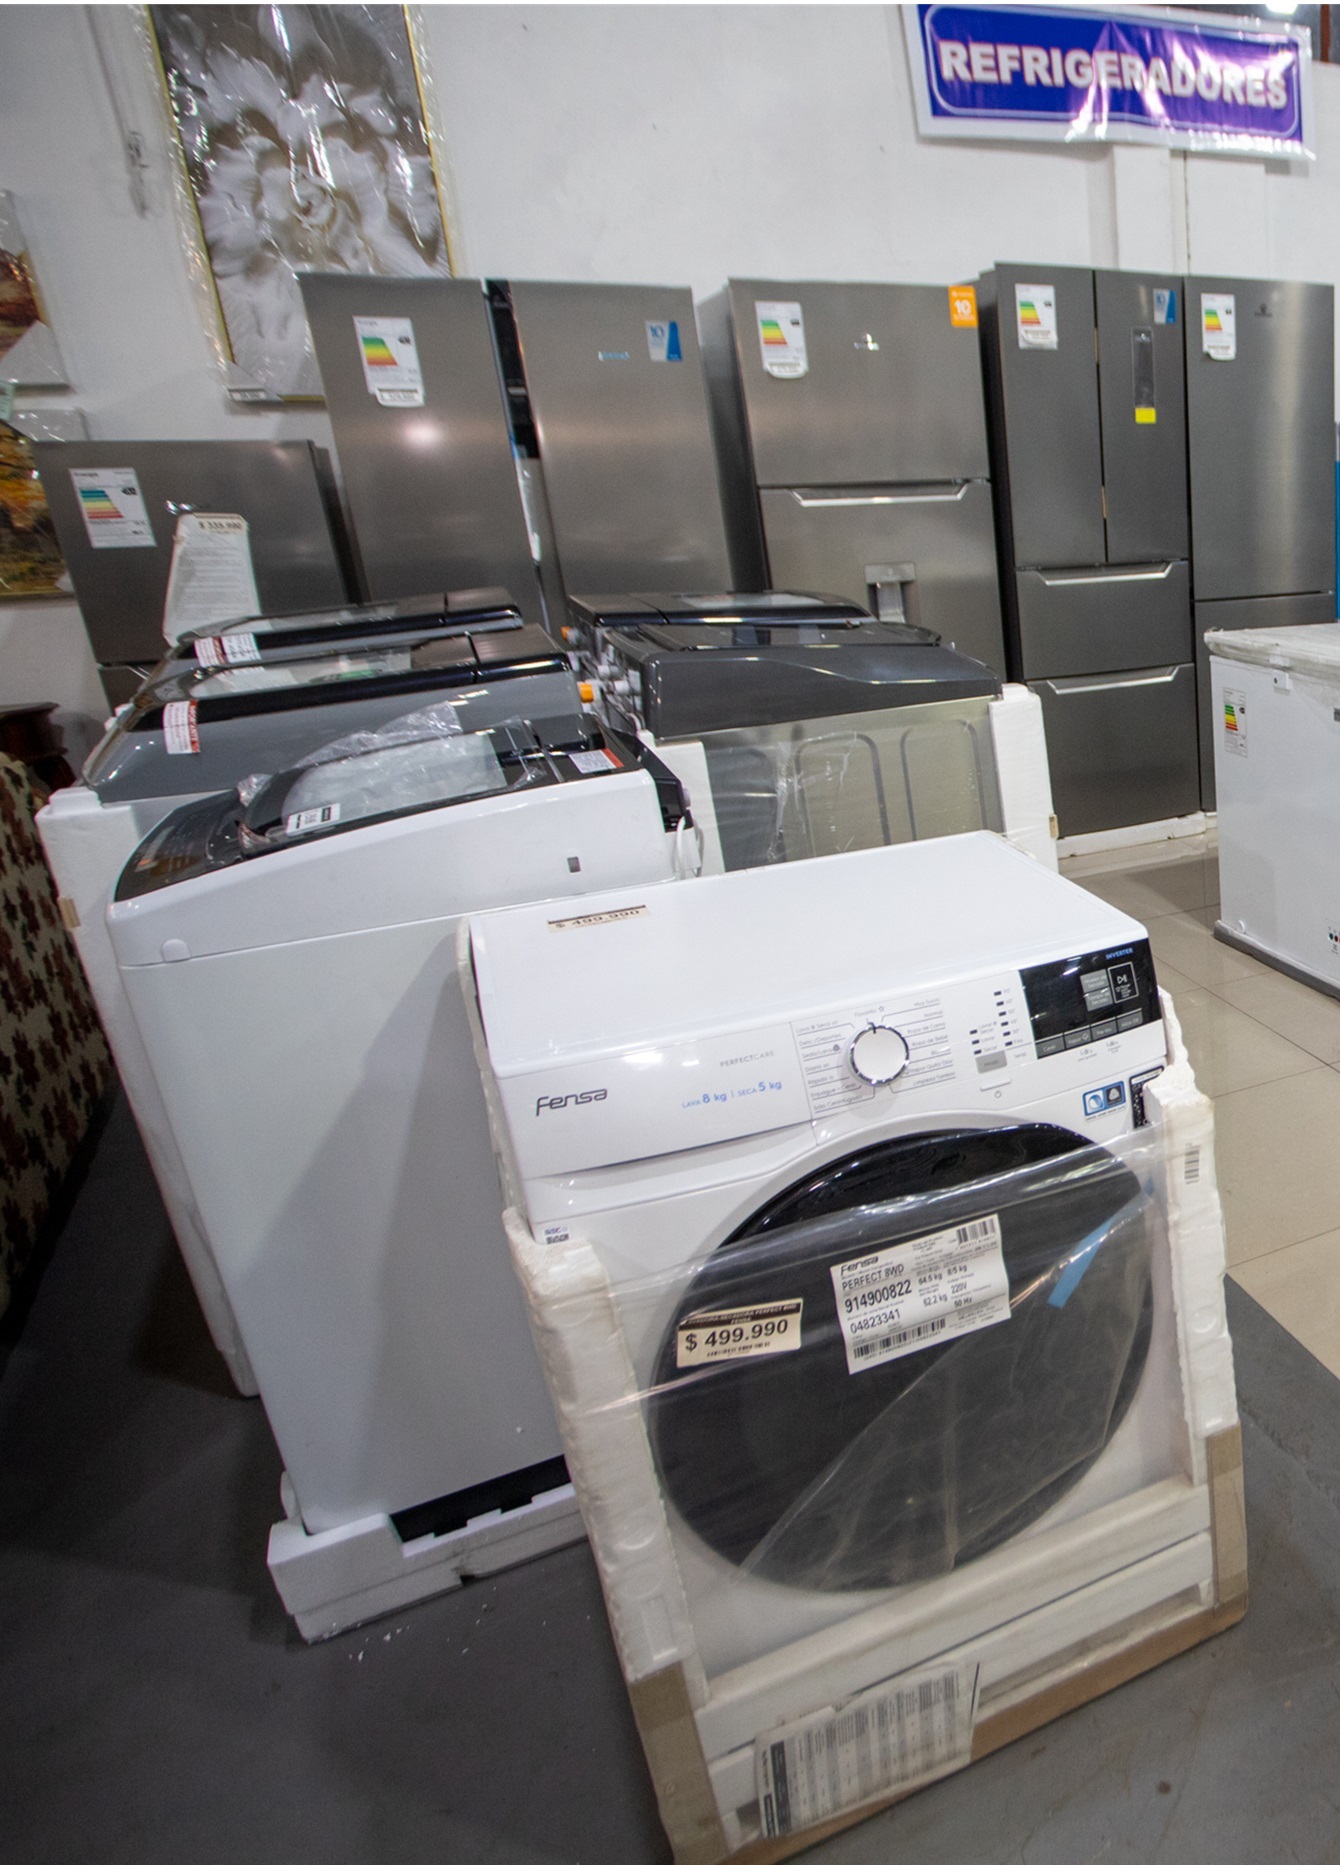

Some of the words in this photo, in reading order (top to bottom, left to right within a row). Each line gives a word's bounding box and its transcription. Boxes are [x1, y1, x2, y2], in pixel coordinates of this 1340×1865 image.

[938, 40, 1289, 110] REFRIGERADORES
[955, 299, 972, 317] 10
[649, 324, 665, 341] 10
[1105, 948, 1134, 959] INVERTER
[720, 1050, 775, 1068] PERFECTCARE
[536, 1088, 607, 1117] Fensa
[682, 1100, 701, 1109] LAVA
[702, 1093, 710, 1104] 8
[714, 1091, 727, 1103] kg
[737, 1086, 757, 1096] SECA
[758, 1081, 767, 1092] 5
[769, 1080, 782, 1092] kg
[840, 1256, 879, 1276] Fensa
[842, 1270, 882, 1291] PERFECT
[885, 1264, 905, 1278] 8WD
[959, 1264, 968, 1274] kg
[845, 1279, 912, 1314] 914900822
[939, 1293, 948, 1304] kg
[850, 1308, 901, 1334] 04823341
[685, 1333, 698, 1352] $
[704, 1319, 788, 1347] 499.990
